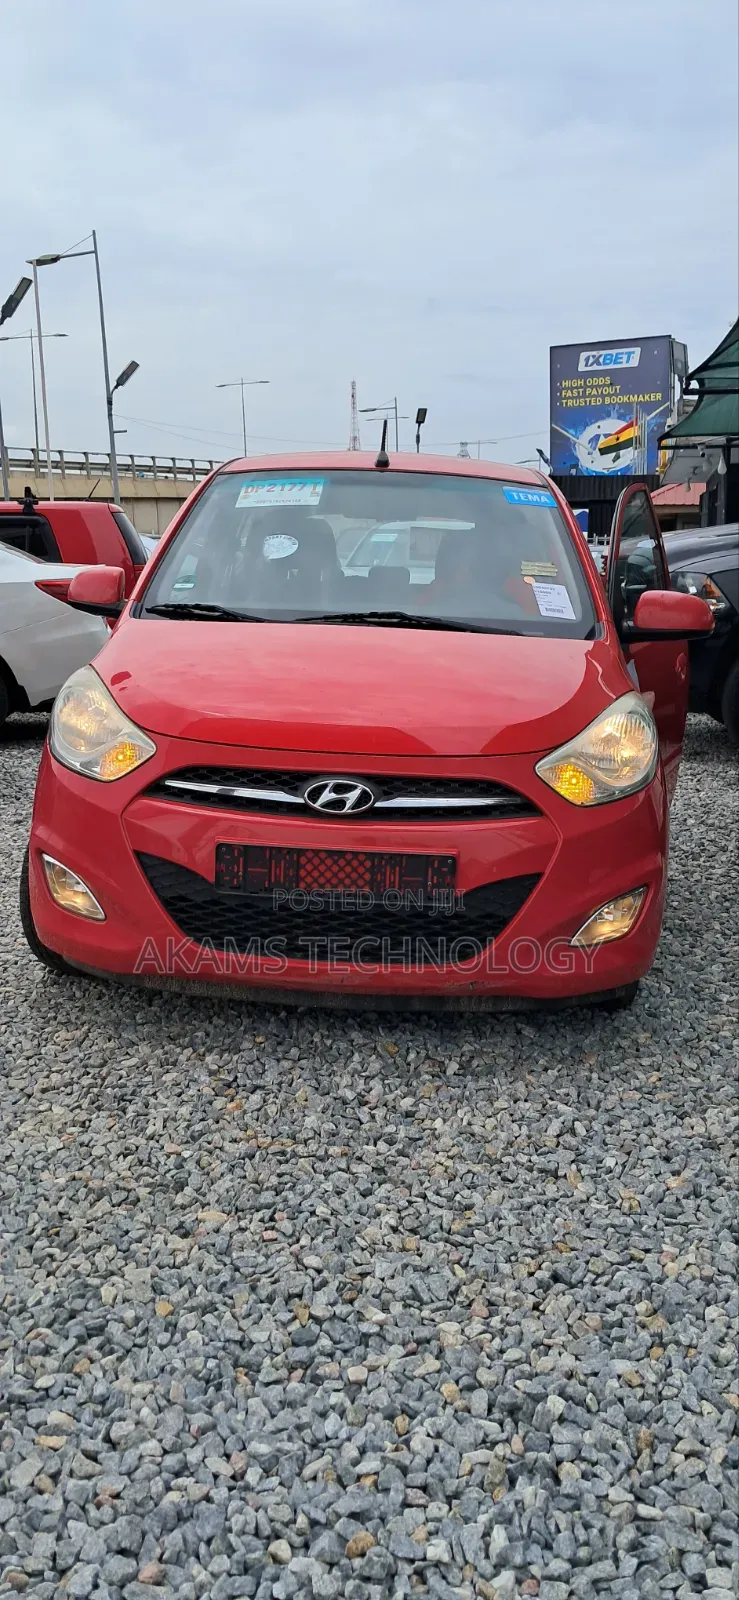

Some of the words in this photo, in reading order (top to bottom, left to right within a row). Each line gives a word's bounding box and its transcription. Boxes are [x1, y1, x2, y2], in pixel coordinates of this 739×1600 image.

[583, 351, 635, 367] 1XBET
[562, 378, 584, 387] HIGH
[586, 377, 611, 386] ODDS
[562, 389, 583, 397] FAST
[586, 386, 621, 395] PAYOUT
[562, 397, 602, 407] TRUSTED
[604, 393, 662, 404] BOOKMAKER
[511, 492, 550, 504] TEMA
